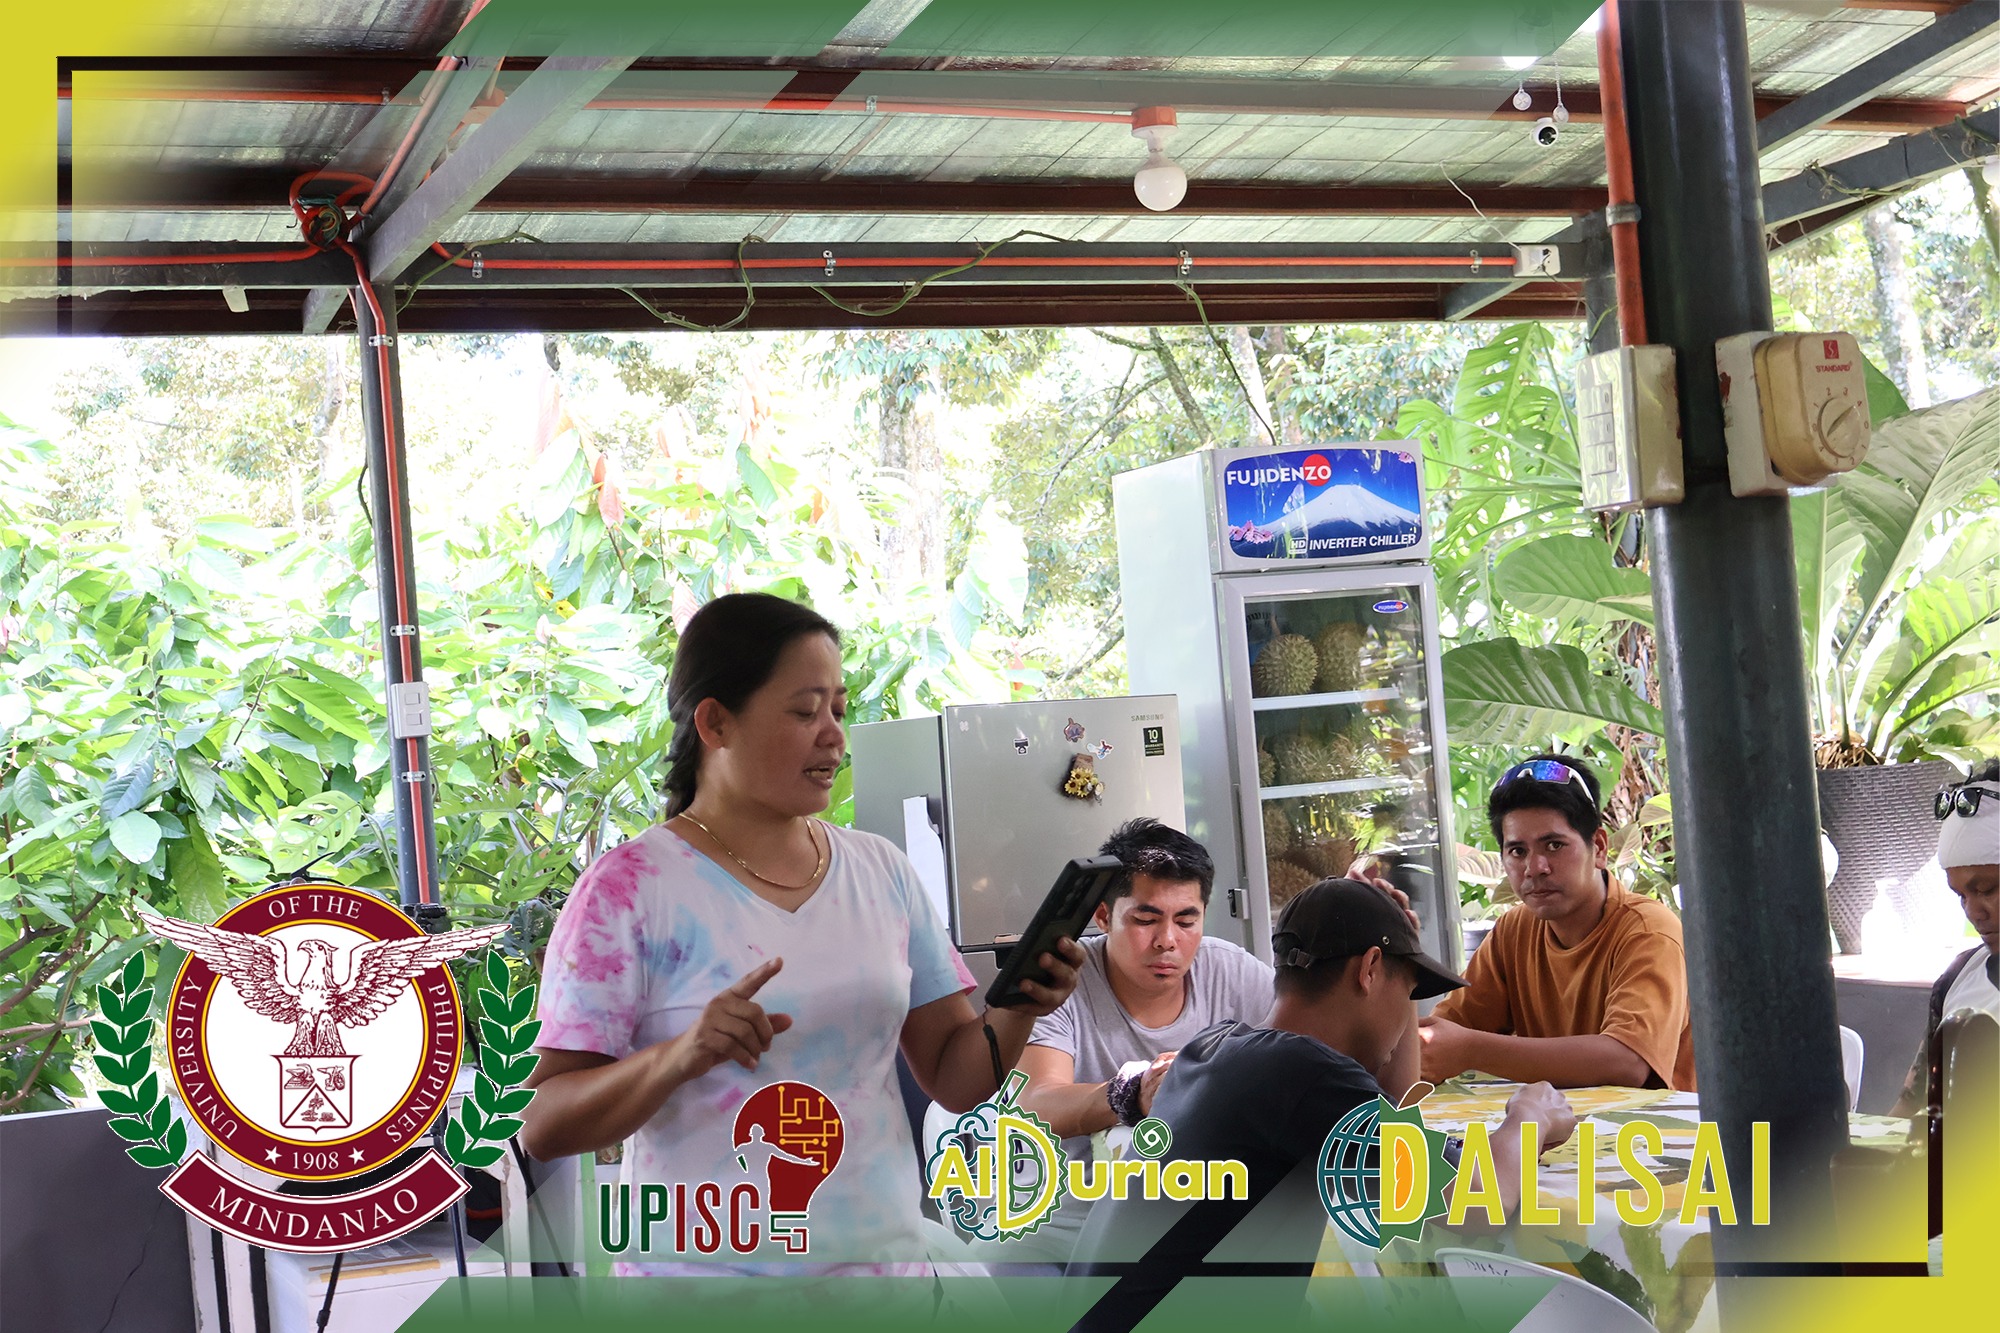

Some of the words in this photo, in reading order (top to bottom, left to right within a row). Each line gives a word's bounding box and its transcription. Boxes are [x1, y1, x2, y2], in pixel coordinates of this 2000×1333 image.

[1815, 365, 1850, 373] STANDARD
[1226, 465, 1332, 486] FUJIDENZO
[1290, 540, 1307, 550] HD
[1309, 536, 1367, 551] INVERTER
[1368, 533, 1417, 547] CHILLER
[1147, 729, 1158, 739] 10
